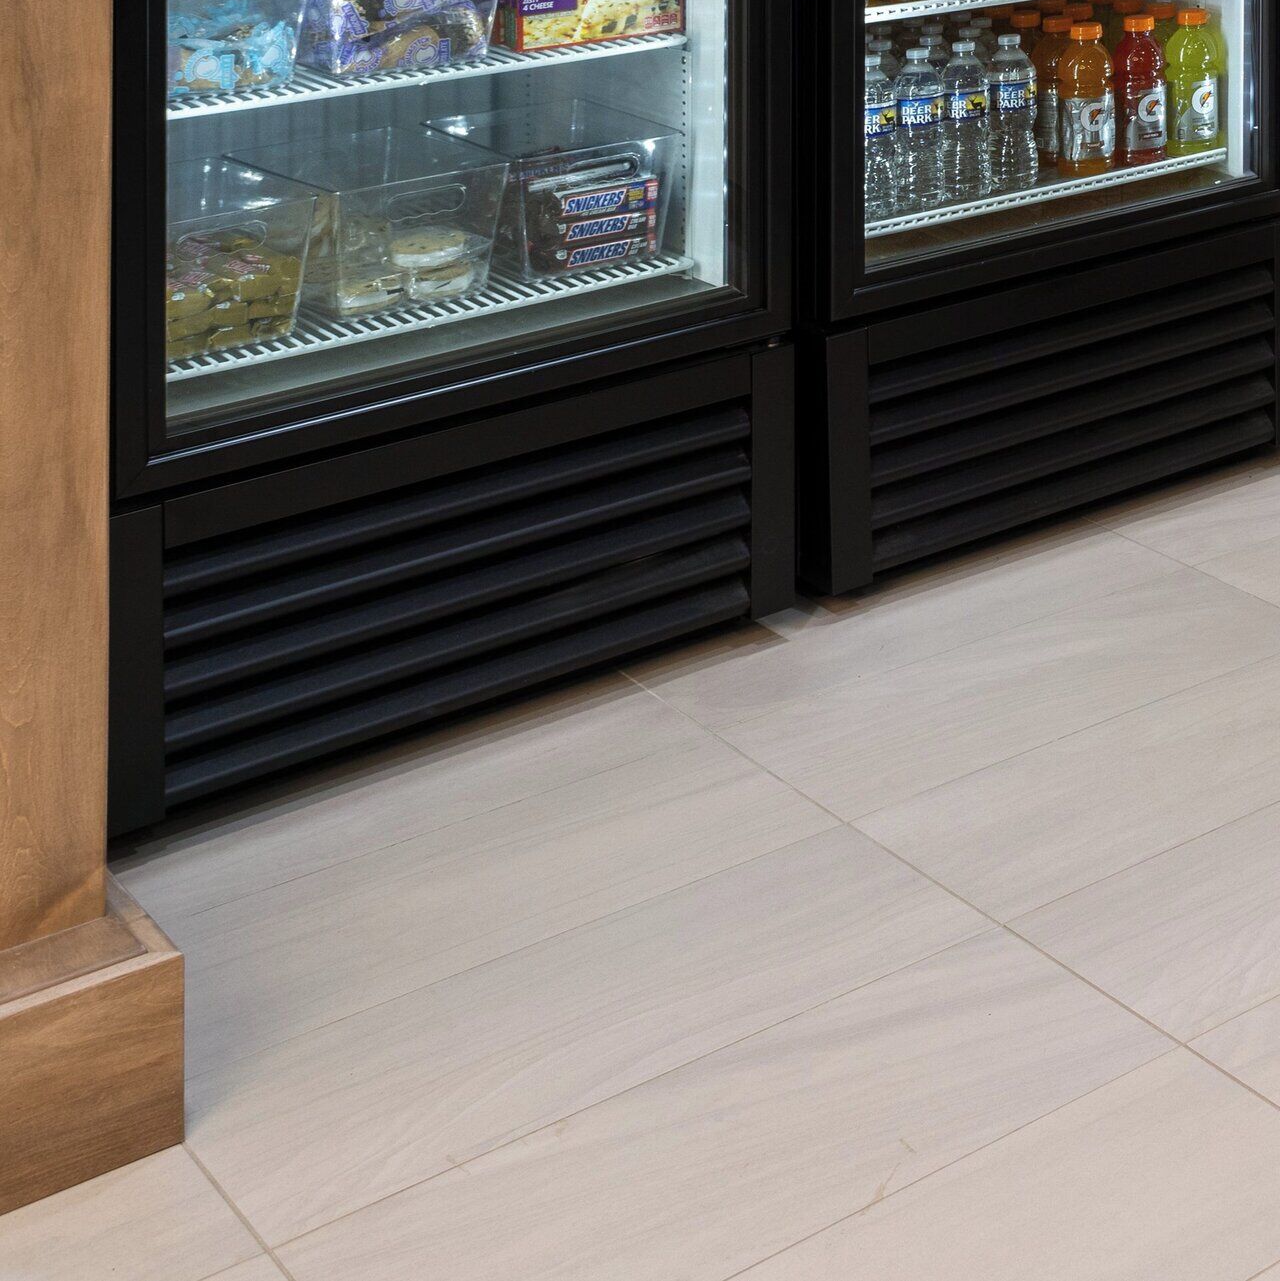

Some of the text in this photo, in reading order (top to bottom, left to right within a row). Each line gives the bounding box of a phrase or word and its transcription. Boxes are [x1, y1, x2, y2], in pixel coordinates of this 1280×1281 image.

[528, 1, 553, 10] CHEESE
[996, 89, 1024, 100] DEER
[902, 104, 932, 115] DEER
[996, 100, 1025, 110] PARK
[902, 114, 932, 125] PARK
[565, 190, 625, 214] SNICKERS
[569, 216, 627, 239] SNICKERS
[570, 241, 628, 265] SNICKERS
